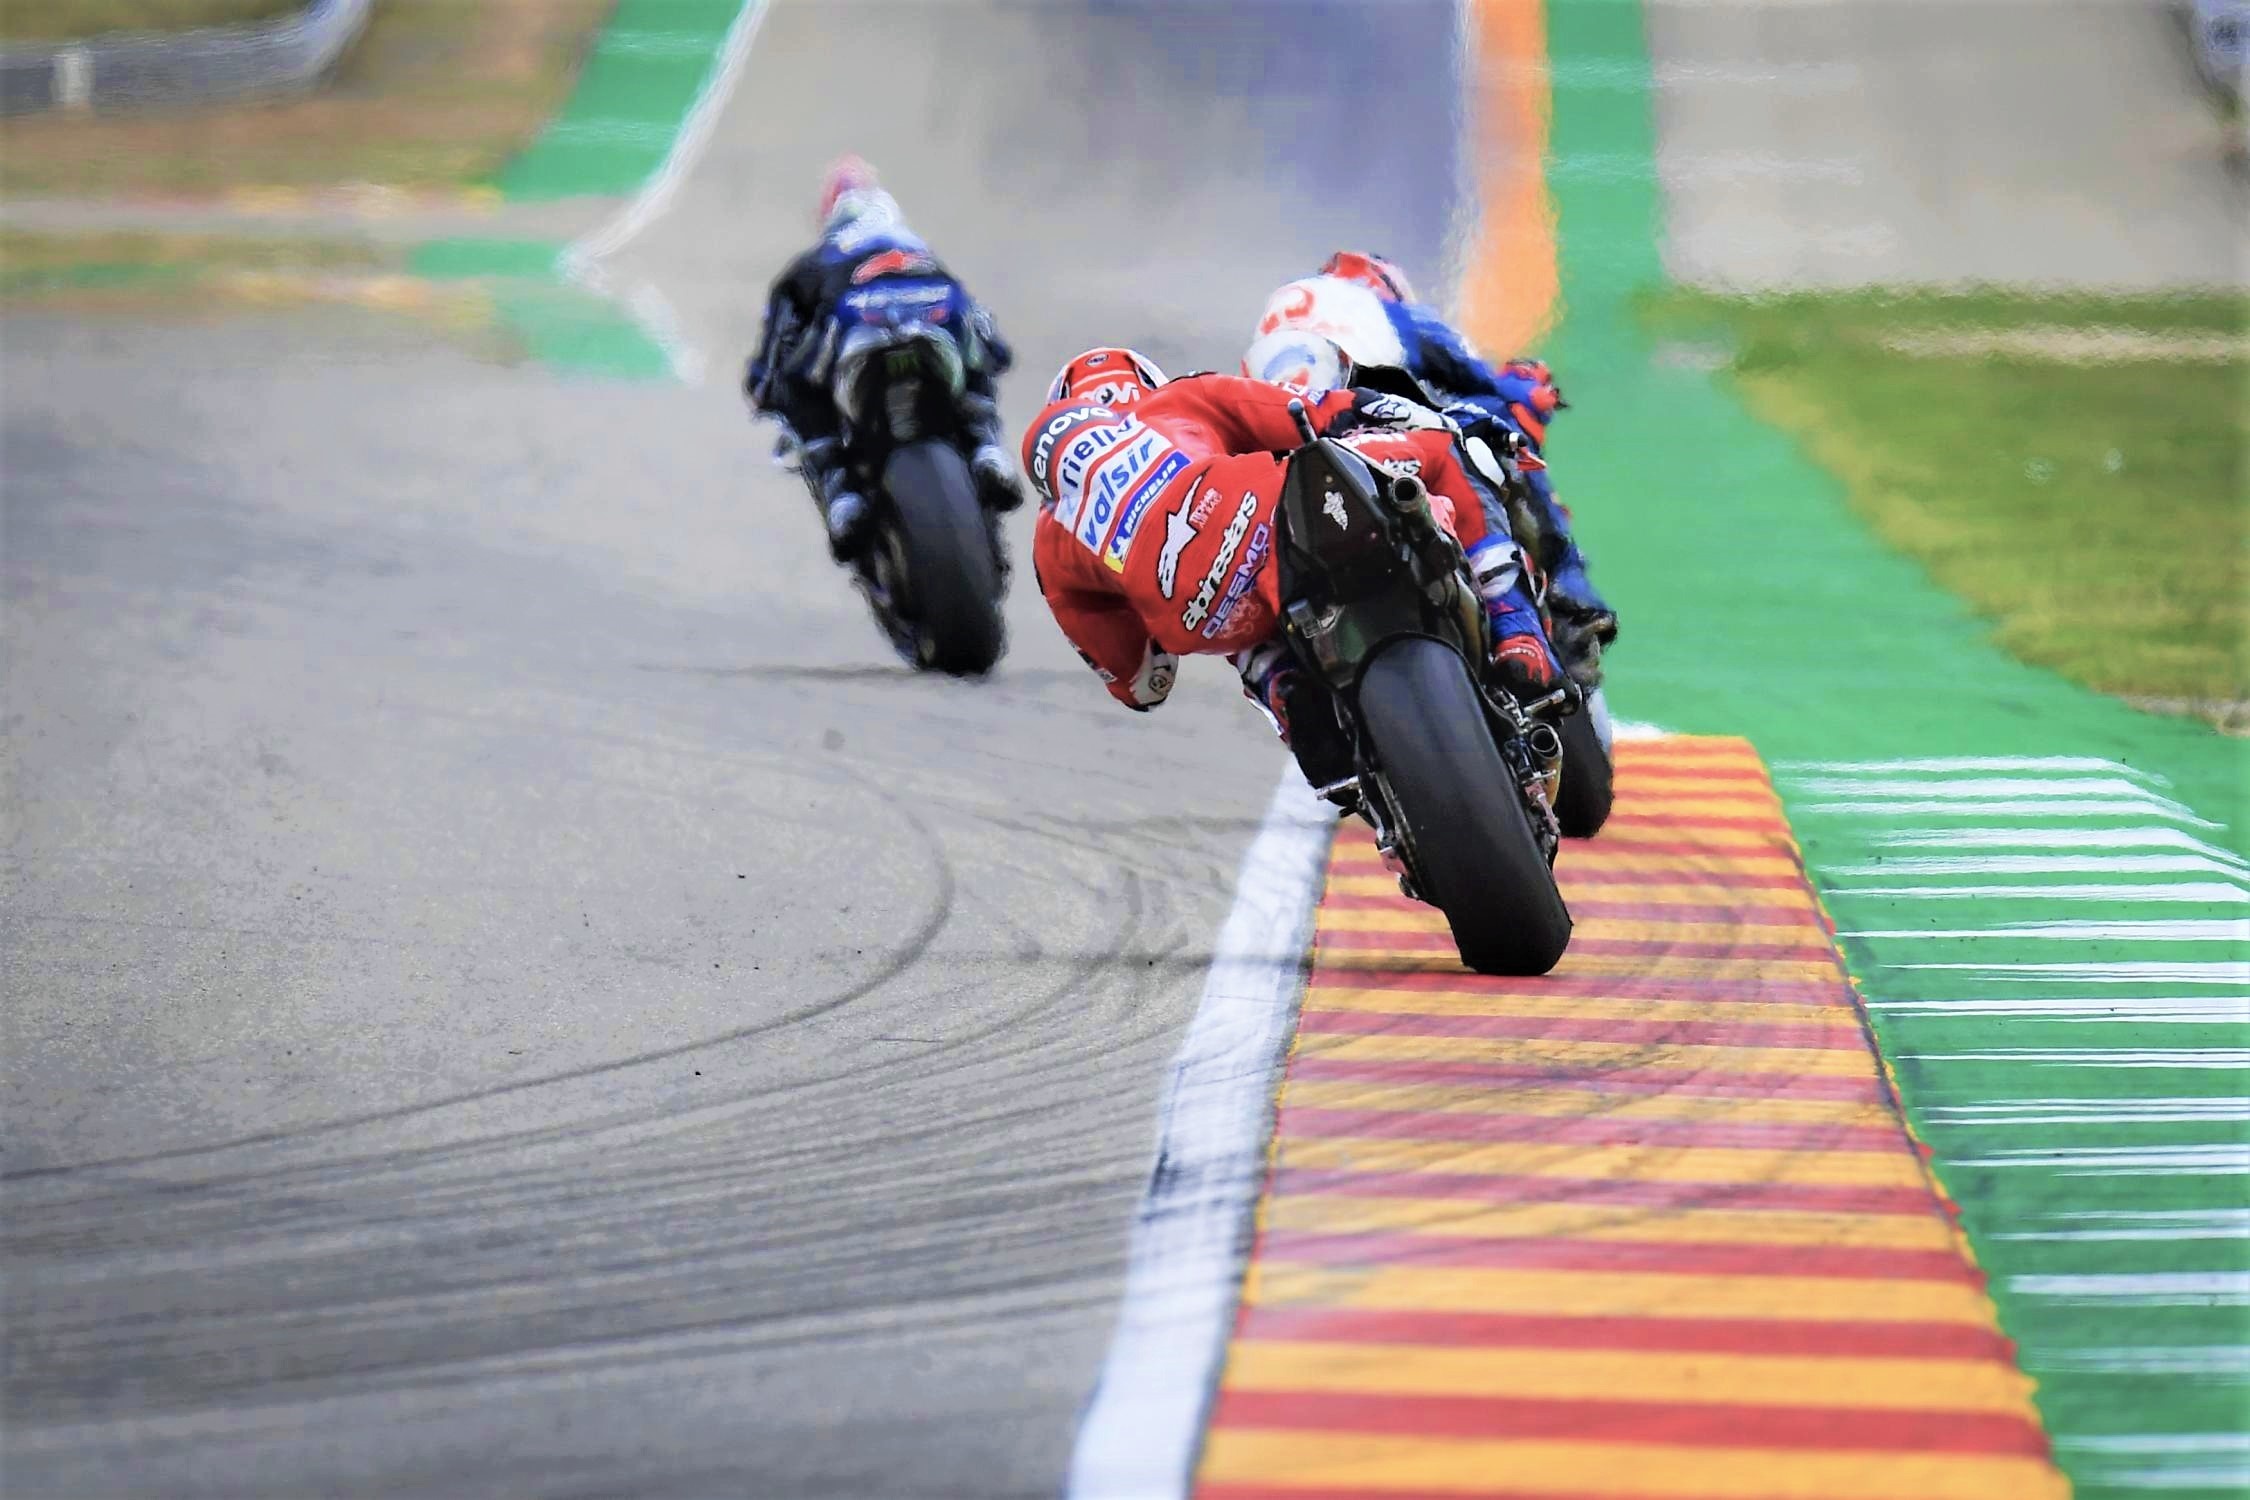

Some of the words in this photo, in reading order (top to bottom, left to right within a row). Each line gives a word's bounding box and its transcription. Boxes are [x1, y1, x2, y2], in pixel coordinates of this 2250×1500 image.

[1084, 438, 1152, 547] valsir
[1124, 460, 1178, 532] MICHELIN
[1183, 491, 1258, 631] alpinestars
